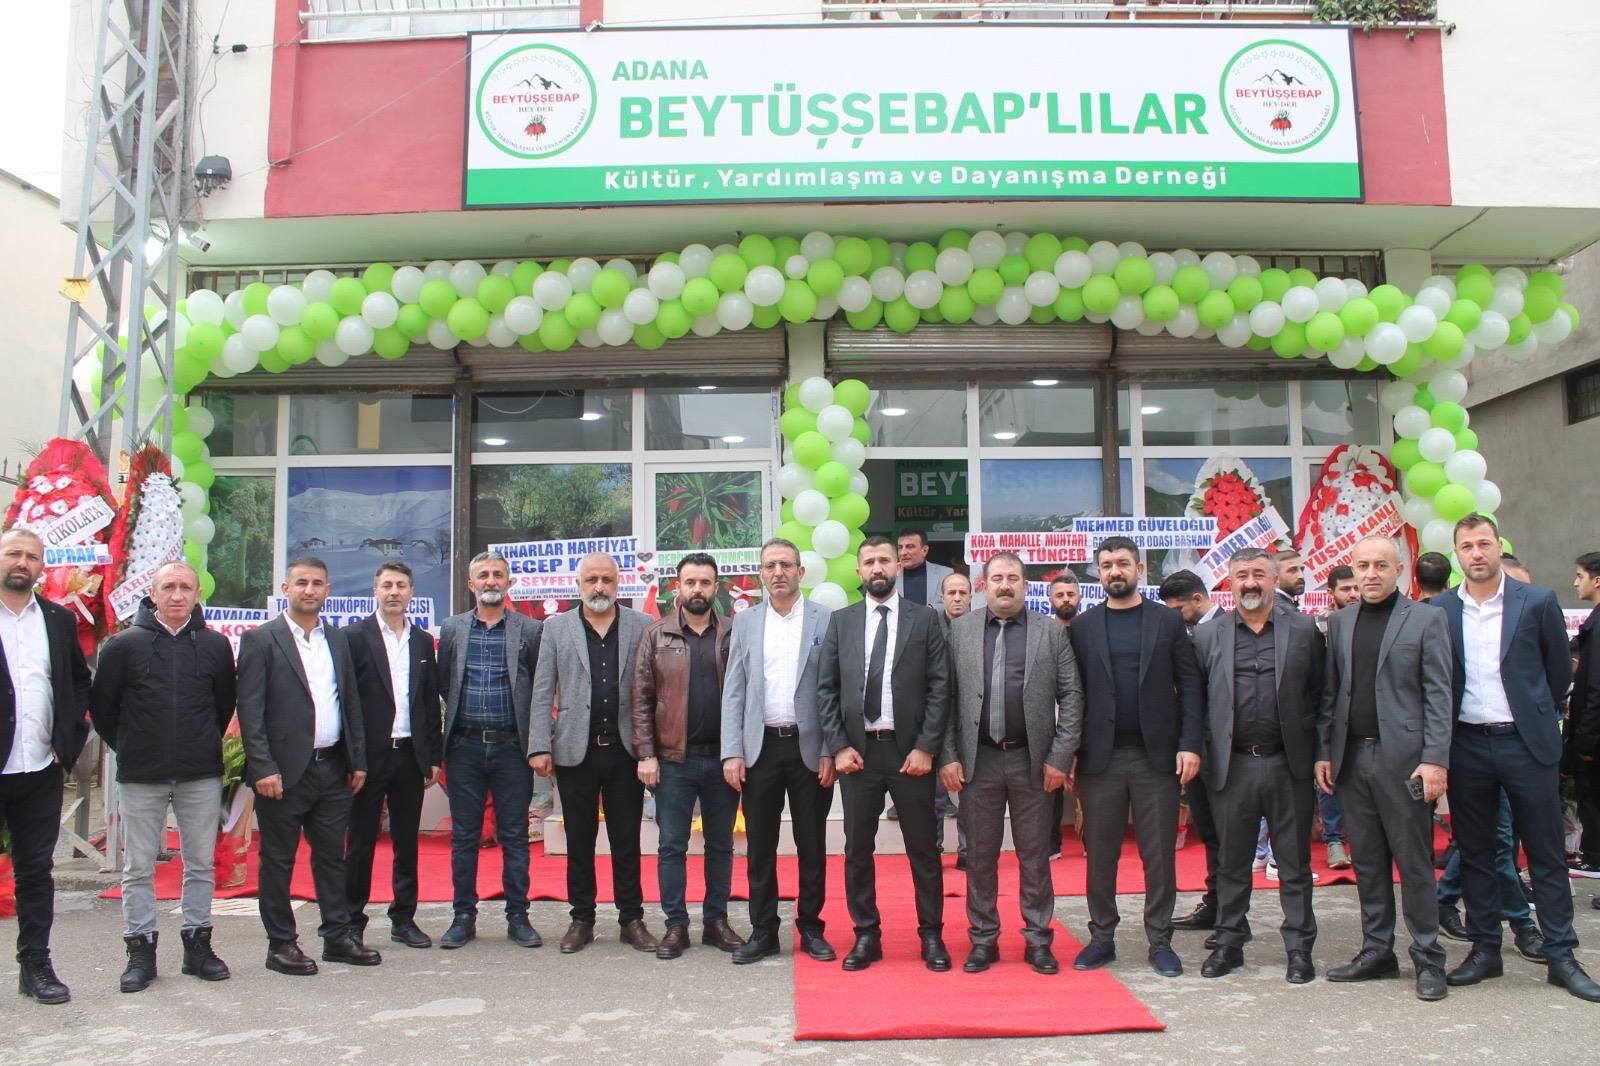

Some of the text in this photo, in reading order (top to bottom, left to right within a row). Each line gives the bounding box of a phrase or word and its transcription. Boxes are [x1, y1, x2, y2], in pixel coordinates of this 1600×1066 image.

[612, 59, 709, 81] ADANA
[493, 91, 580, 105] BEYTÜŞŞEBAP
[1235, 87, 1322, 100] BEYTÜŞŞEBAP
[619, 82, 1209, 150] BEYTÜŞŞEBAP'LILAR
[717, 167, 903, 191] Yardımlaşma
[911, 170, 943, 185] ve
[951, 165, 1107, 189] Dayanışma
[1115, 165, 1227, 190] Derneği
[1075, 517, 1215, 532] MEHMED GÜVELOĞLU
[971, 534, 995, 548] KOZA
[999, 533, 1041, 548] MAHALLE
[1044, 533, 1088, 547] MUHTARI
[1147, 534, 1172, 548] ODASI
[1303, 498, 1397, 571] YUSUF KANLI
[46, 548, 96, 565] OPRAK
[1202, 533, 1249, 570] TAMER
[511, 558, 563, 574] ECEP
[720, 563, 761, 575] OLSU
